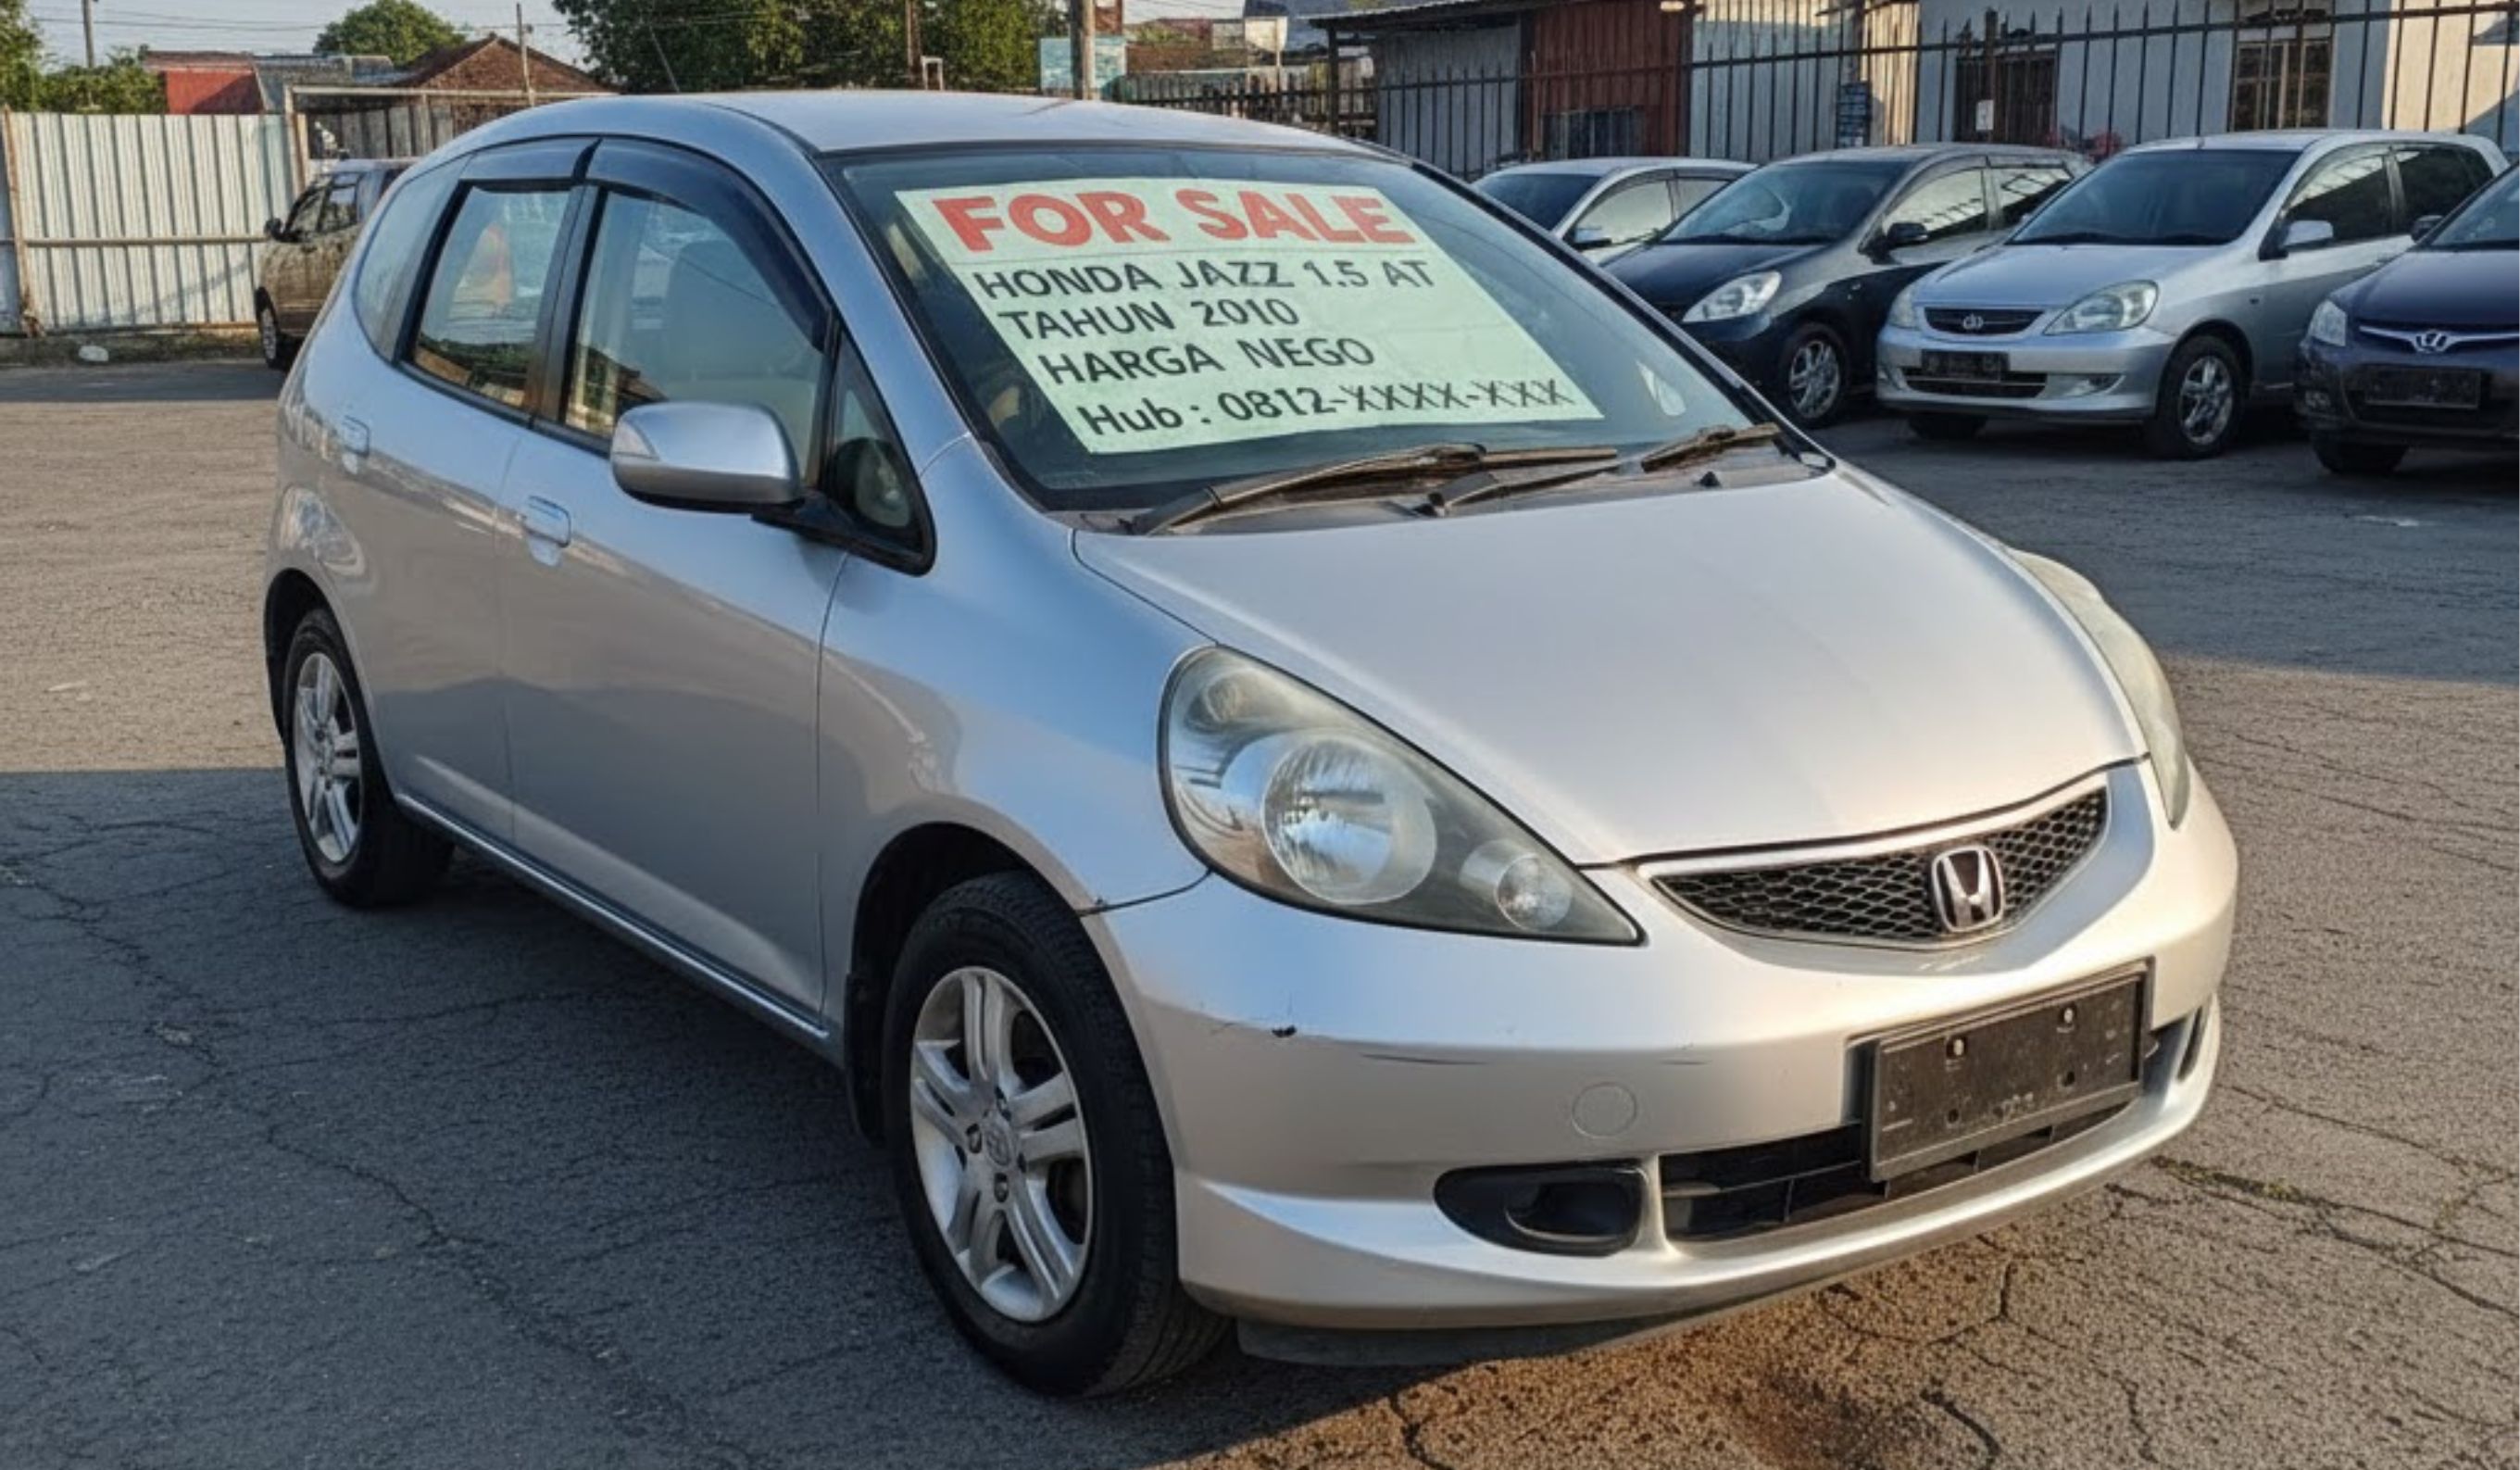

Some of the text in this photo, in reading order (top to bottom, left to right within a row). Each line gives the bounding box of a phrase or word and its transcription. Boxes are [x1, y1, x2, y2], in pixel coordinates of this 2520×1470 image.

[932, 189, 1415, 252] FOR SALE
[972, 259, 1435, 300] HONDA JAZZ 1.5 AT
[997, 298, 1300, 340] TAHUN 2010
[1037, 337, 1375, 385] HARGA NEGO
[1075, 397, 1184, 436] Hub
[1217, 378, 1573, 421] 0812-XXXX-XXX
